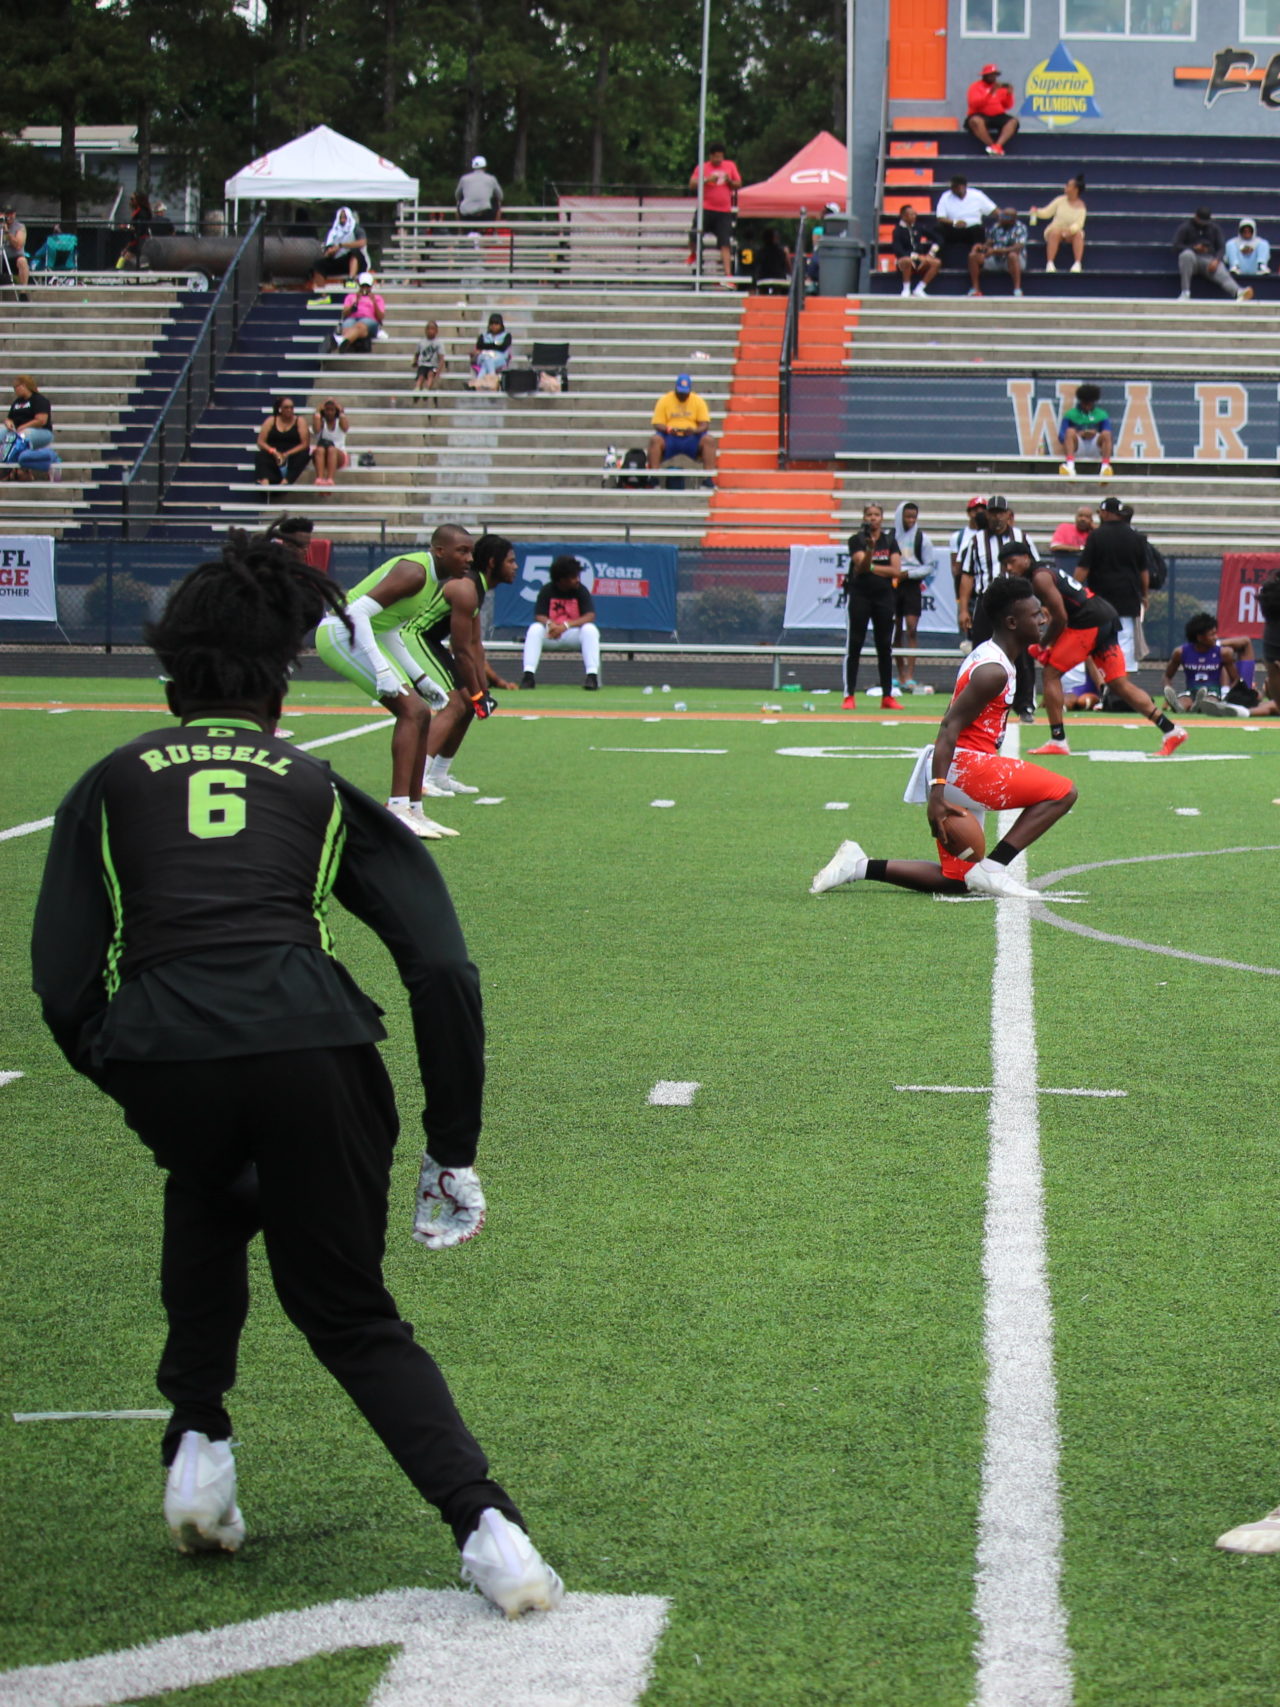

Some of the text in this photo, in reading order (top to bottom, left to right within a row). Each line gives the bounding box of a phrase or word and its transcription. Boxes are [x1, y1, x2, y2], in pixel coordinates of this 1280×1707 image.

[1032, 76, 1088, 94] Superior
[1033, 97, 1087, 112] PLUMBING
[0, 550, 31, 567] FL
[594, 563, 643, 579] Years
[139, 745, 292, 776] RUSSELL
[188, 769, 246, 839] 6
